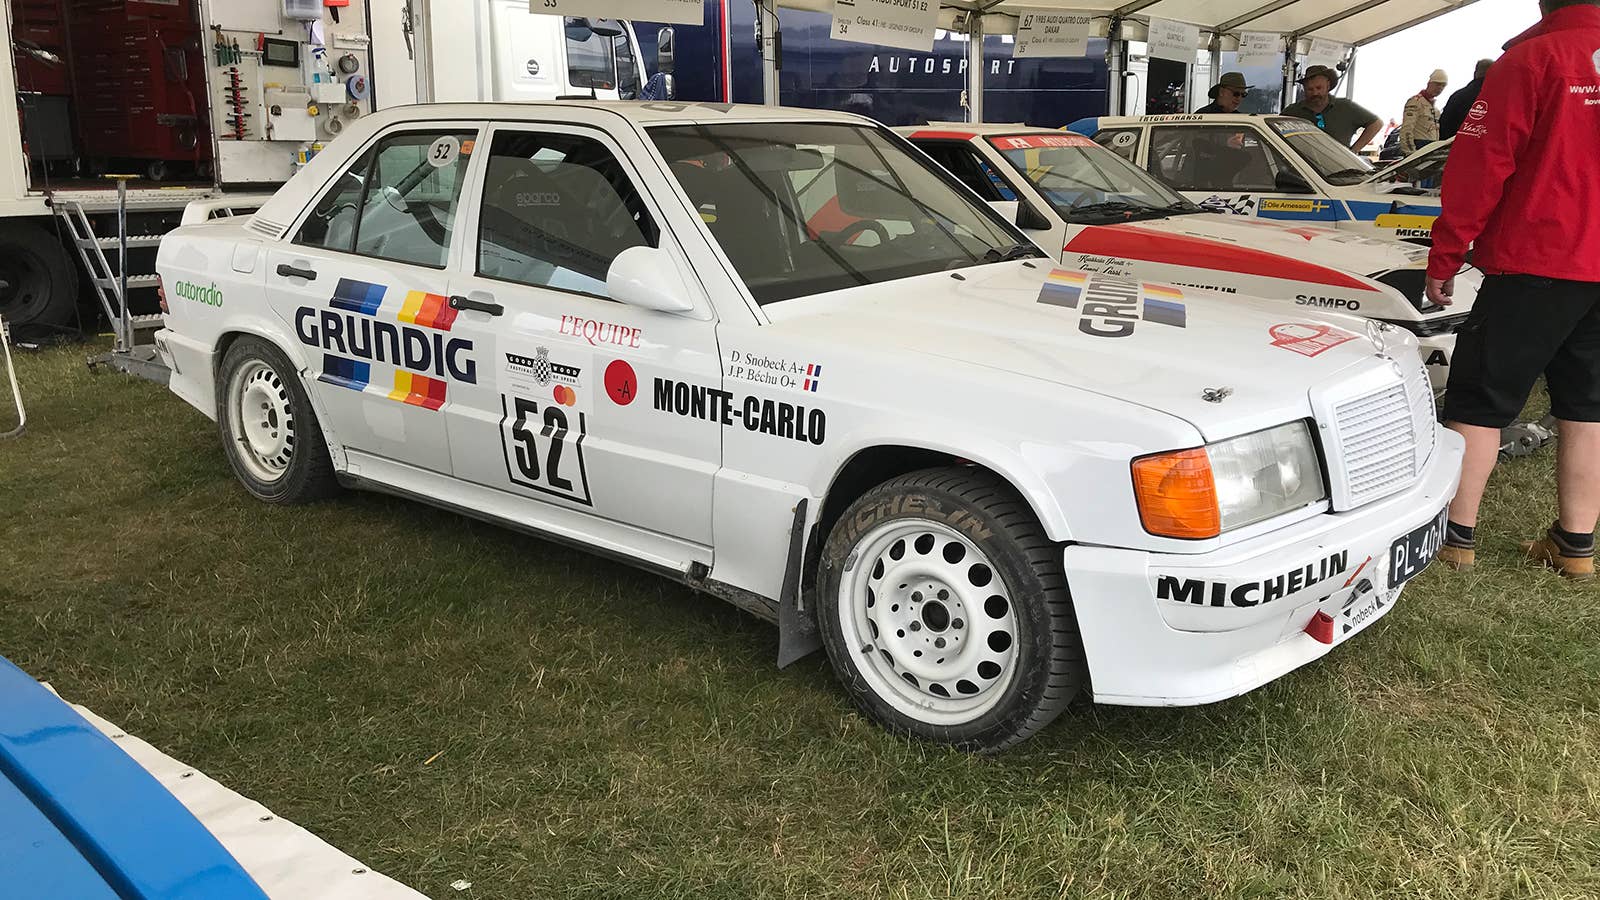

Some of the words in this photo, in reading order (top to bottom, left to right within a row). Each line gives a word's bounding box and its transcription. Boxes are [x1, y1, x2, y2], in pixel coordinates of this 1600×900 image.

[840, 24, 848, 34] 34
[1024, 15, 1034, 27] 67
[868, 56, 1015, 75] AUTOSPRT
[1119, 135, 1130, 144] 69
[434, 143, 450, 159] 52
[175, 280, 223, 308] autoradio
[1295, 294, 1360, 311] SAMPO
[559, 315, 642, 349] L'EQUIPE
[295, 305, 478, 385] GRUNDIG
[731, 350, 742, 363] D.
[745, 353, 787, 372] Snobeck
[788, 361, 805, 374] A+
[728, 365, 744, 380] J.P.
[747, 368, 777, 386] Béchu
[653, 377, 827, 447] MONTE-CARLO
[511, 396, 575, 493] 52
[1157, 549, 1349, 608] MICHELIN
